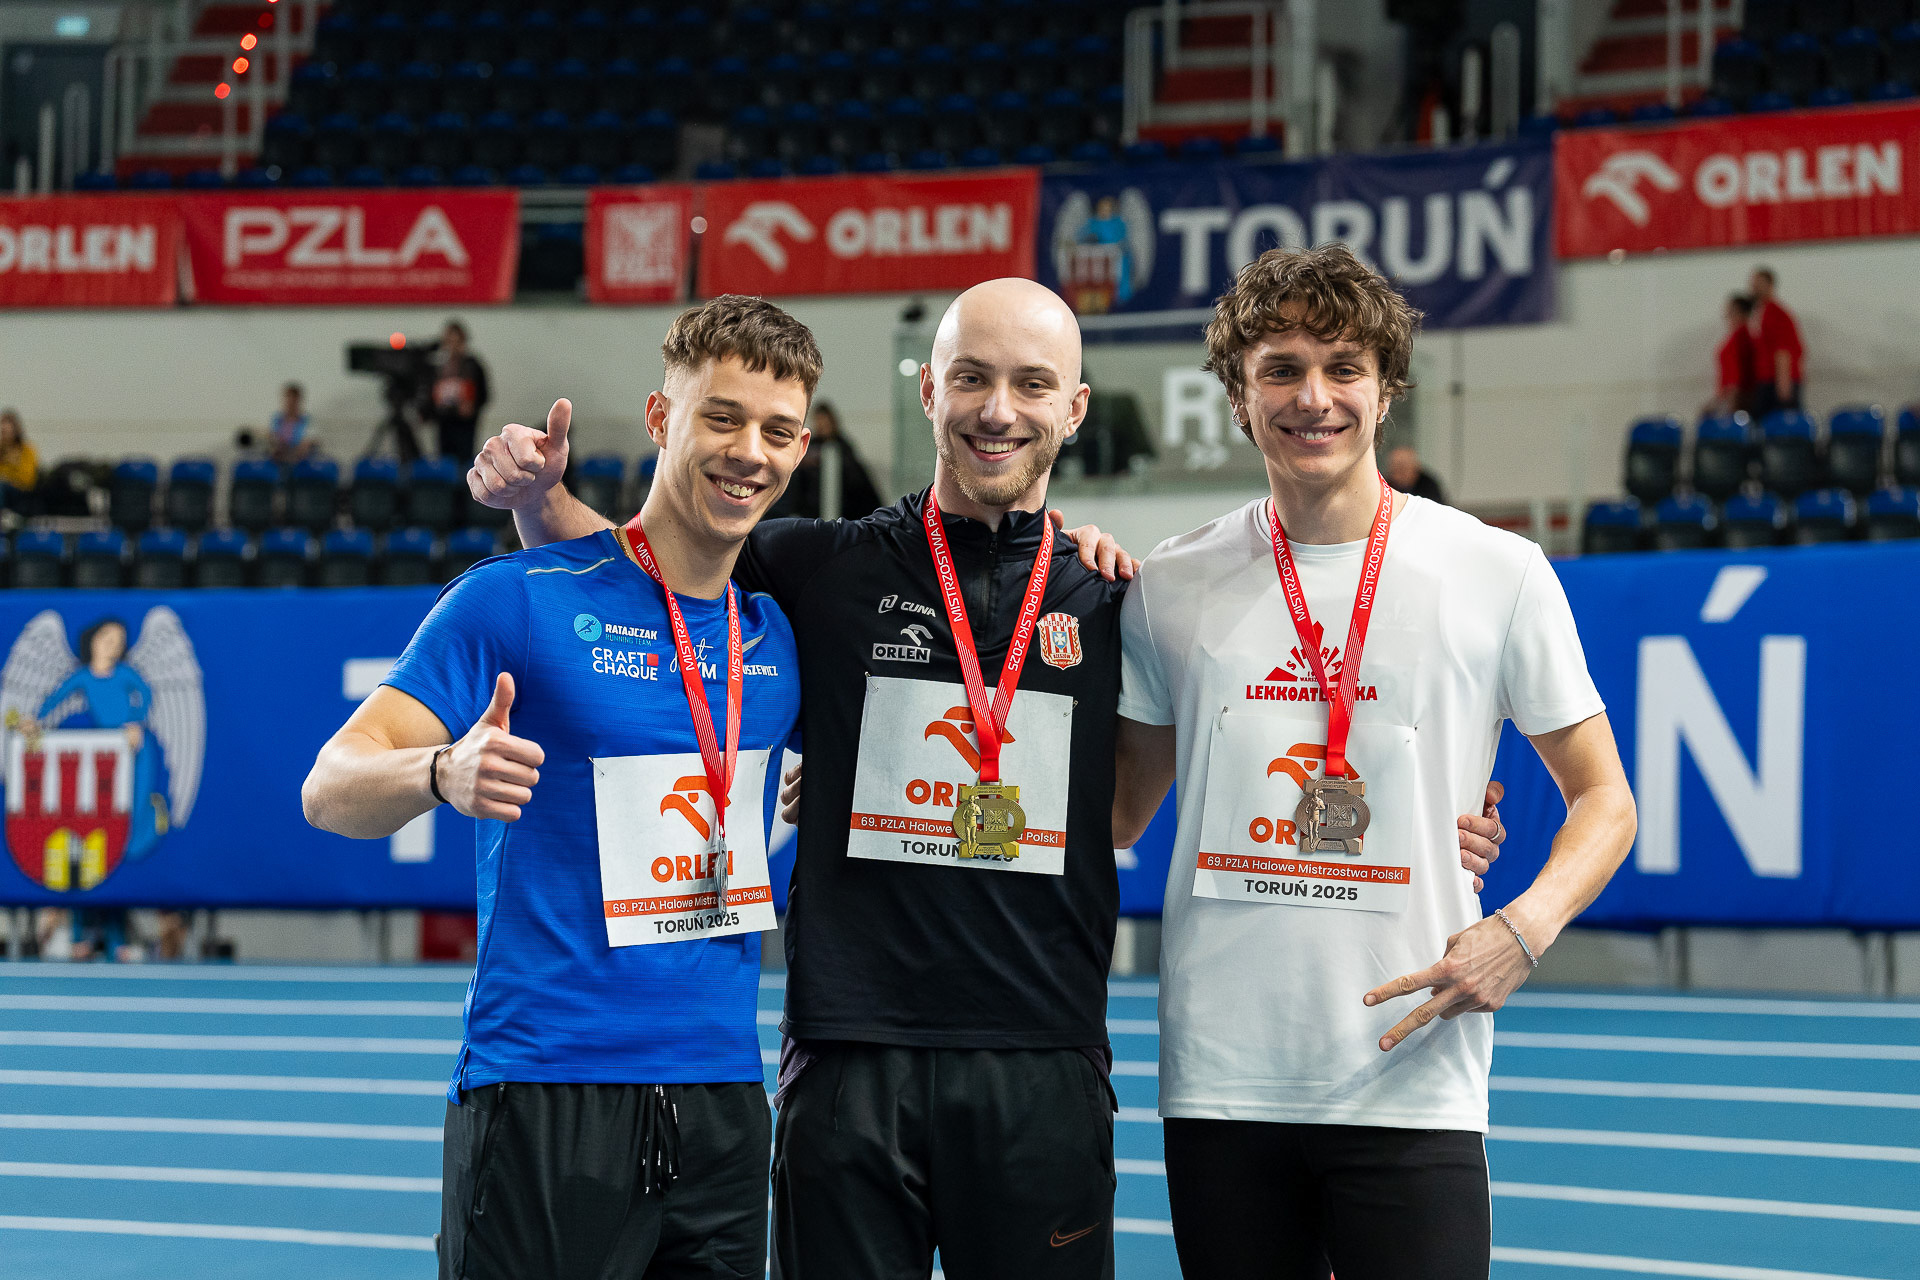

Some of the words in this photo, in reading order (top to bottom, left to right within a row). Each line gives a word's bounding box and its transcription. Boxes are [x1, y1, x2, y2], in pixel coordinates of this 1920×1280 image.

[1695, 141, 1901, 209] ORLEN
[223, 206, 470, 267] PZLA
[825, 204, 1014, 258] ORLEN
[931, 527, 963, 622] MISTRZOSTWA
[1273, 533, 1306, 622] MISTRZOSTWA
[1359, 522, 1387, 609] MISTRZOSTWA
[901, 601, 936, 617] CUNA
[1020, 594, 1039, 638] POLSKI
[605, 624, 658, 640] RATAJCZAK
[605, 634, 634, 644] RUNNING
[635, 639, 652, 647] TEAM
[591, 647, 647, 665] CRAFT
[875, 646, 928, 661] ORLEN
[1008, 640, 1026, 672] 2025
[592, 660, 658, 681] CHAQUE
[1246, 685, 1378, 702] LEKKOATLEKA
[860, 816, 878, 828] 69.
[880, 819, 906, 830] PZLA
[909, 821, 952, 834] Halowe
[1026, 832, 1058, 844] Polski
[1207, 856, 1223, 868] 69.
[1225, 858, 1250, 869] PZLA
[1252, 860, 1296, 873] Halowe
[1298, 863, 1368, 879] Mistrzostwa
[1371, 869, 1404, 880] Polski
[612, 903, 630, 914] 69.
[631, 900, 657, 913] PZLA
[659, 898, 693, 911] Halowe
[743, 888, 767, 901] Polski
[1244, 879, 1308, 897] TORUŃ
[1312, 884, 1358, 901] 2025
[654, 912, 704, 934] TORUŃ
[706, 911, 740, 929] 2025
